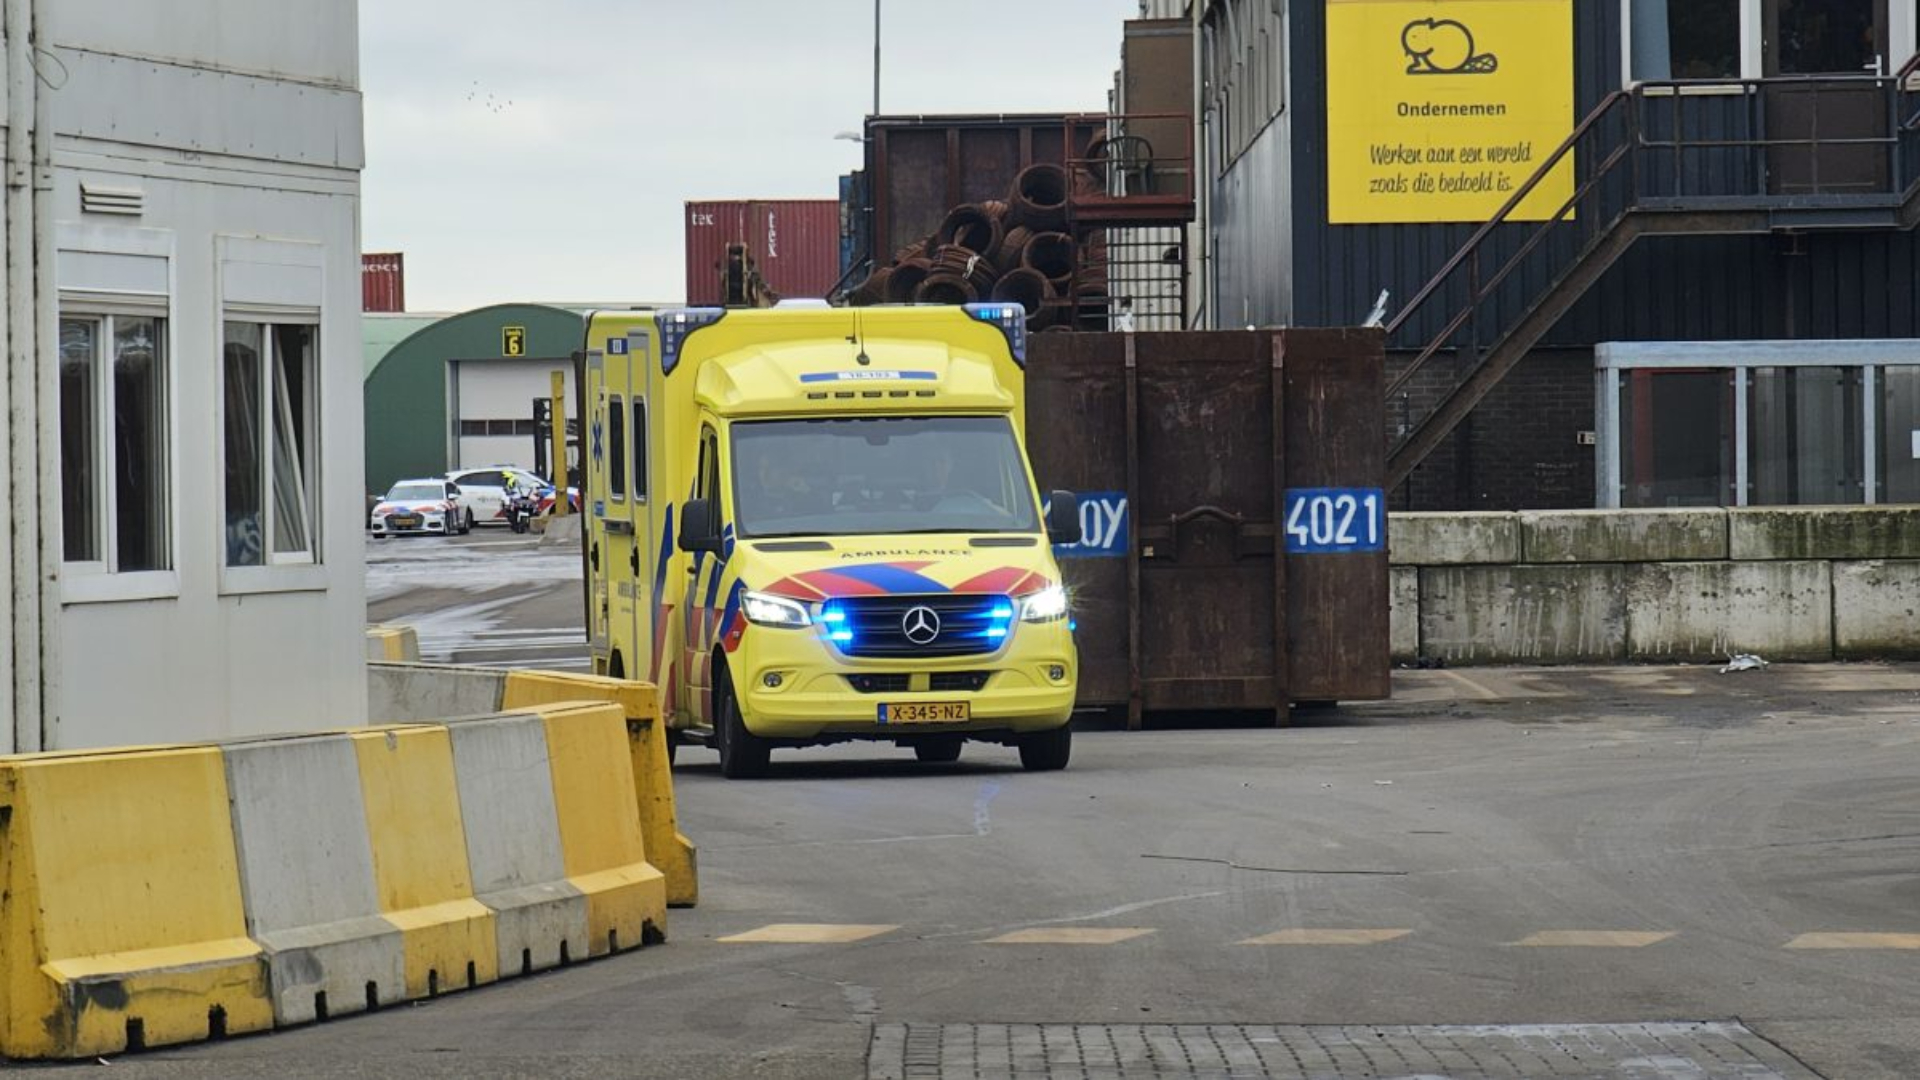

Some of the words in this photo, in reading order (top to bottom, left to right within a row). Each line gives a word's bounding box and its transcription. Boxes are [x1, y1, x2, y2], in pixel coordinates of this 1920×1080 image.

[1397, 101, 1506, 116] Ondernemen
[1370, 143, 1422, 165] Werken
[1426, 148, 1455, 163] aan
[1459, 148, 1483, 163] een
[1487, 141, 1531, 163] wereld
[1369, 172, 1408, 193] zoals
[1412, 171, 1435, 193] die
[1439, 171, 1493, 192] bedoeld
[1497, 170, 1513, 191] is.
[509, 336, 519, 354] 6
[1287, 495, 1377, 546] 4021
[841, 548, 973, 558] AMBULANCE
[894, 704, 964, 719] X-345-NZ
